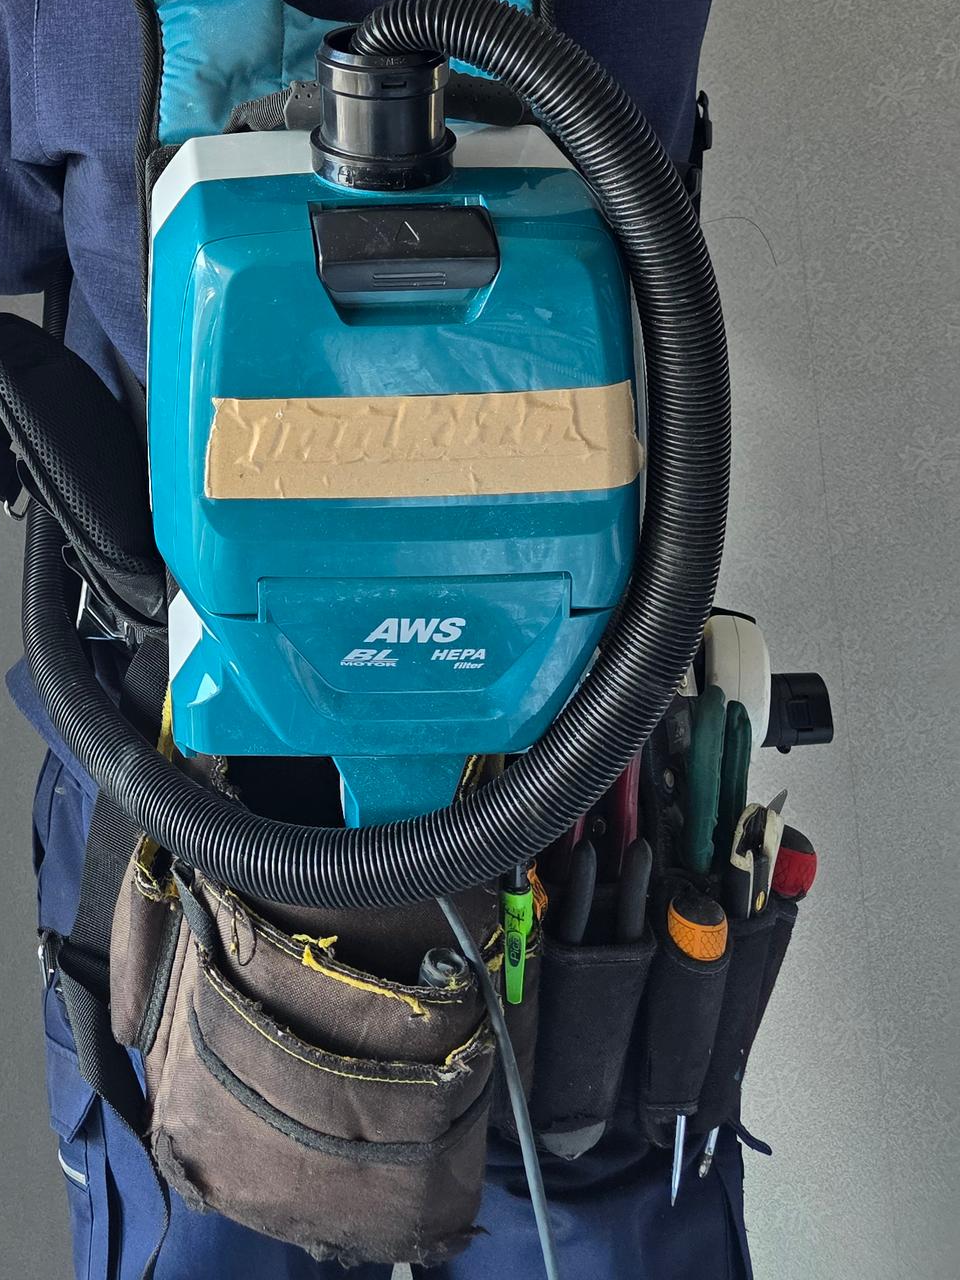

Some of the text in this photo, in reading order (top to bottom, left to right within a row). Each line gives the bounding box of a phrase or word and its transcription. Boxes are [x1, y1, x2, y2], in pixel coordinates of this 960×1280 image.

[363, 617, 466, 644] AWS
[343, 648, 399, 661] BL
[430, 648, 486, 661] HEPA
[453, 661, 484, 670] filter
